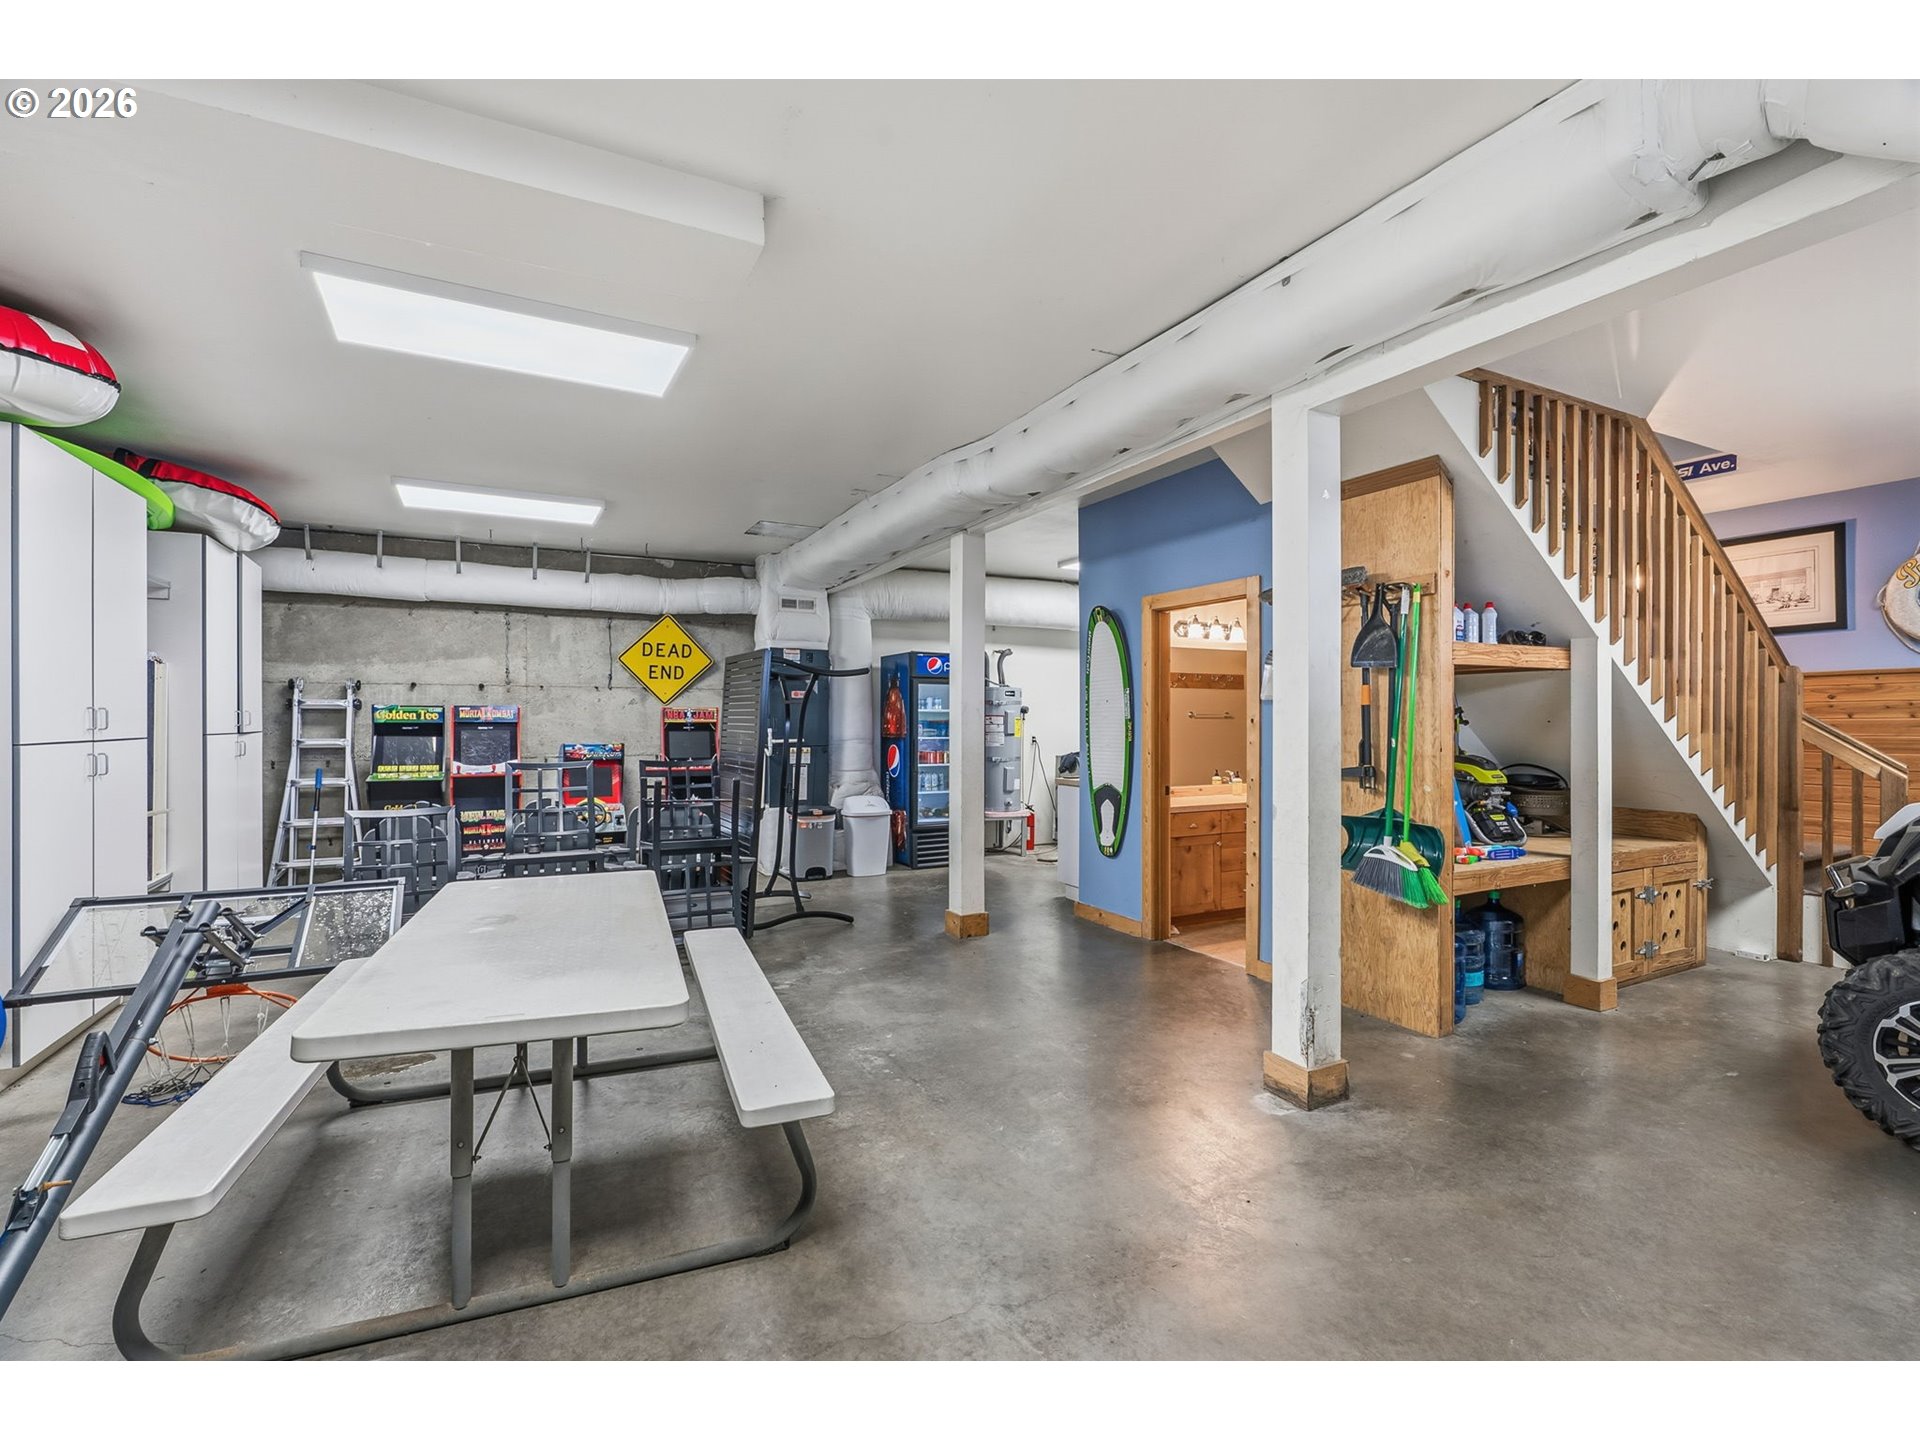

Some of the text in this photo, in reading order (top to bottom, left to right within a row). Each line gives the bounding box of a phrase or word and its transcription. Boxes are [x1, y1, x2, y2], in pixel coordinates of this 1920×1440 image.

[1677, 460, 1735, 478] SI Ave.
[642, 642, 692, 659] DEAD
[649, 664, 684, 681] END
[374, 709, 417, 721] Golden
[666, 710, 714, 720] NBA JAM
